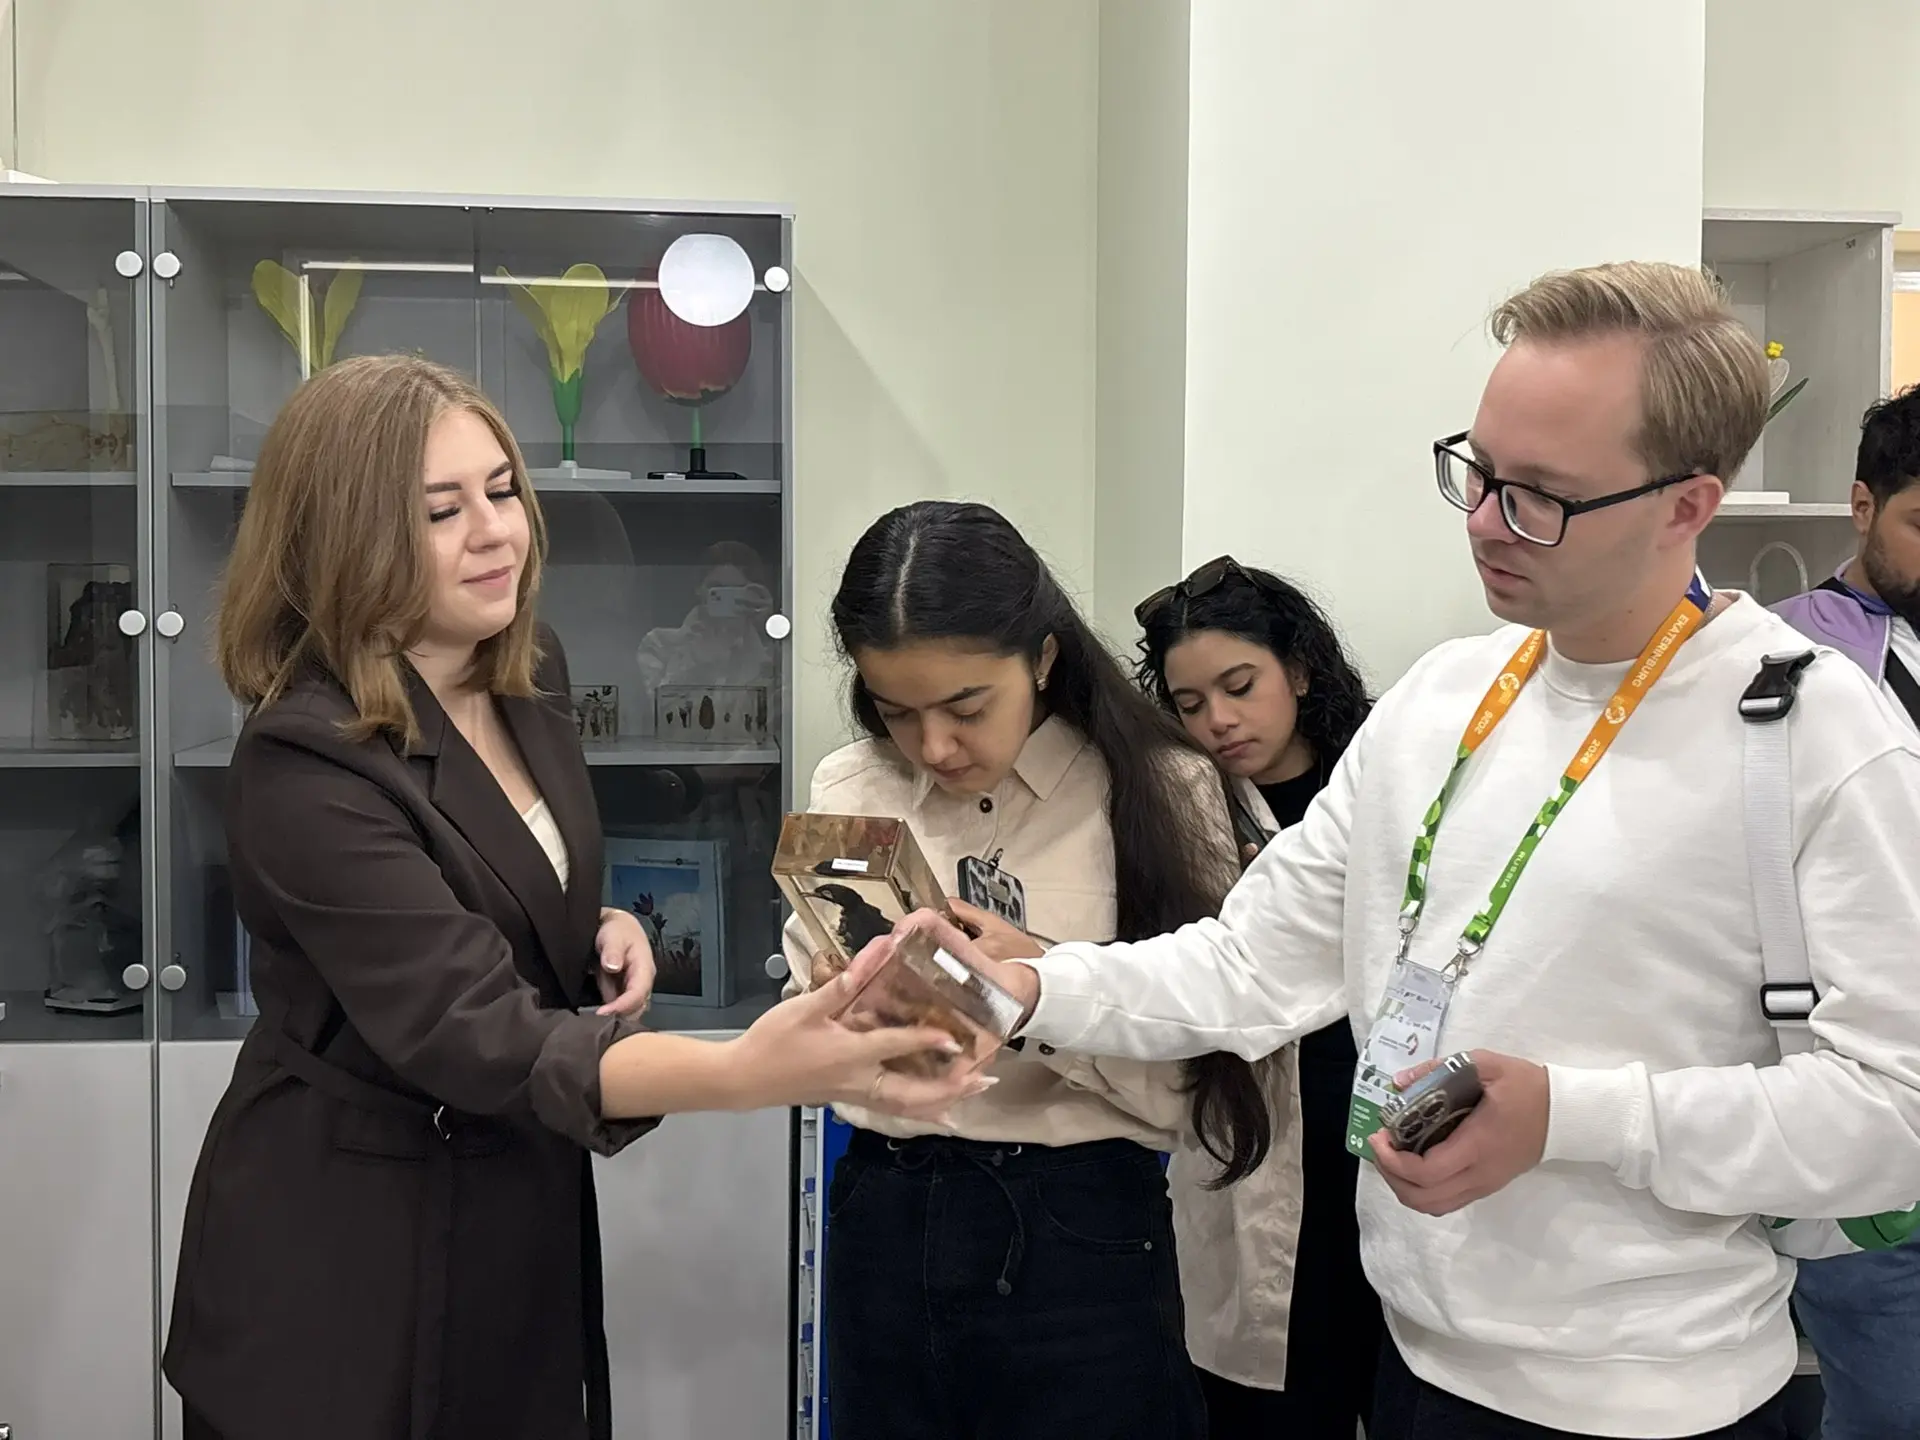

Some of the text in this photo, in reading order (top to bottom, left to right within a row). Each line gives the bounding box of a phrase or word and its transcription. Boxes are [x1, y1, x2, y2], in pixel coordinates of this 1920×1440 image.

[1579, 613, 1690, 765] EKATERINBURG 2026
[1473, 709, 1494, 735] 2026
[1499, 850, 1526, 889] RUSSIA
